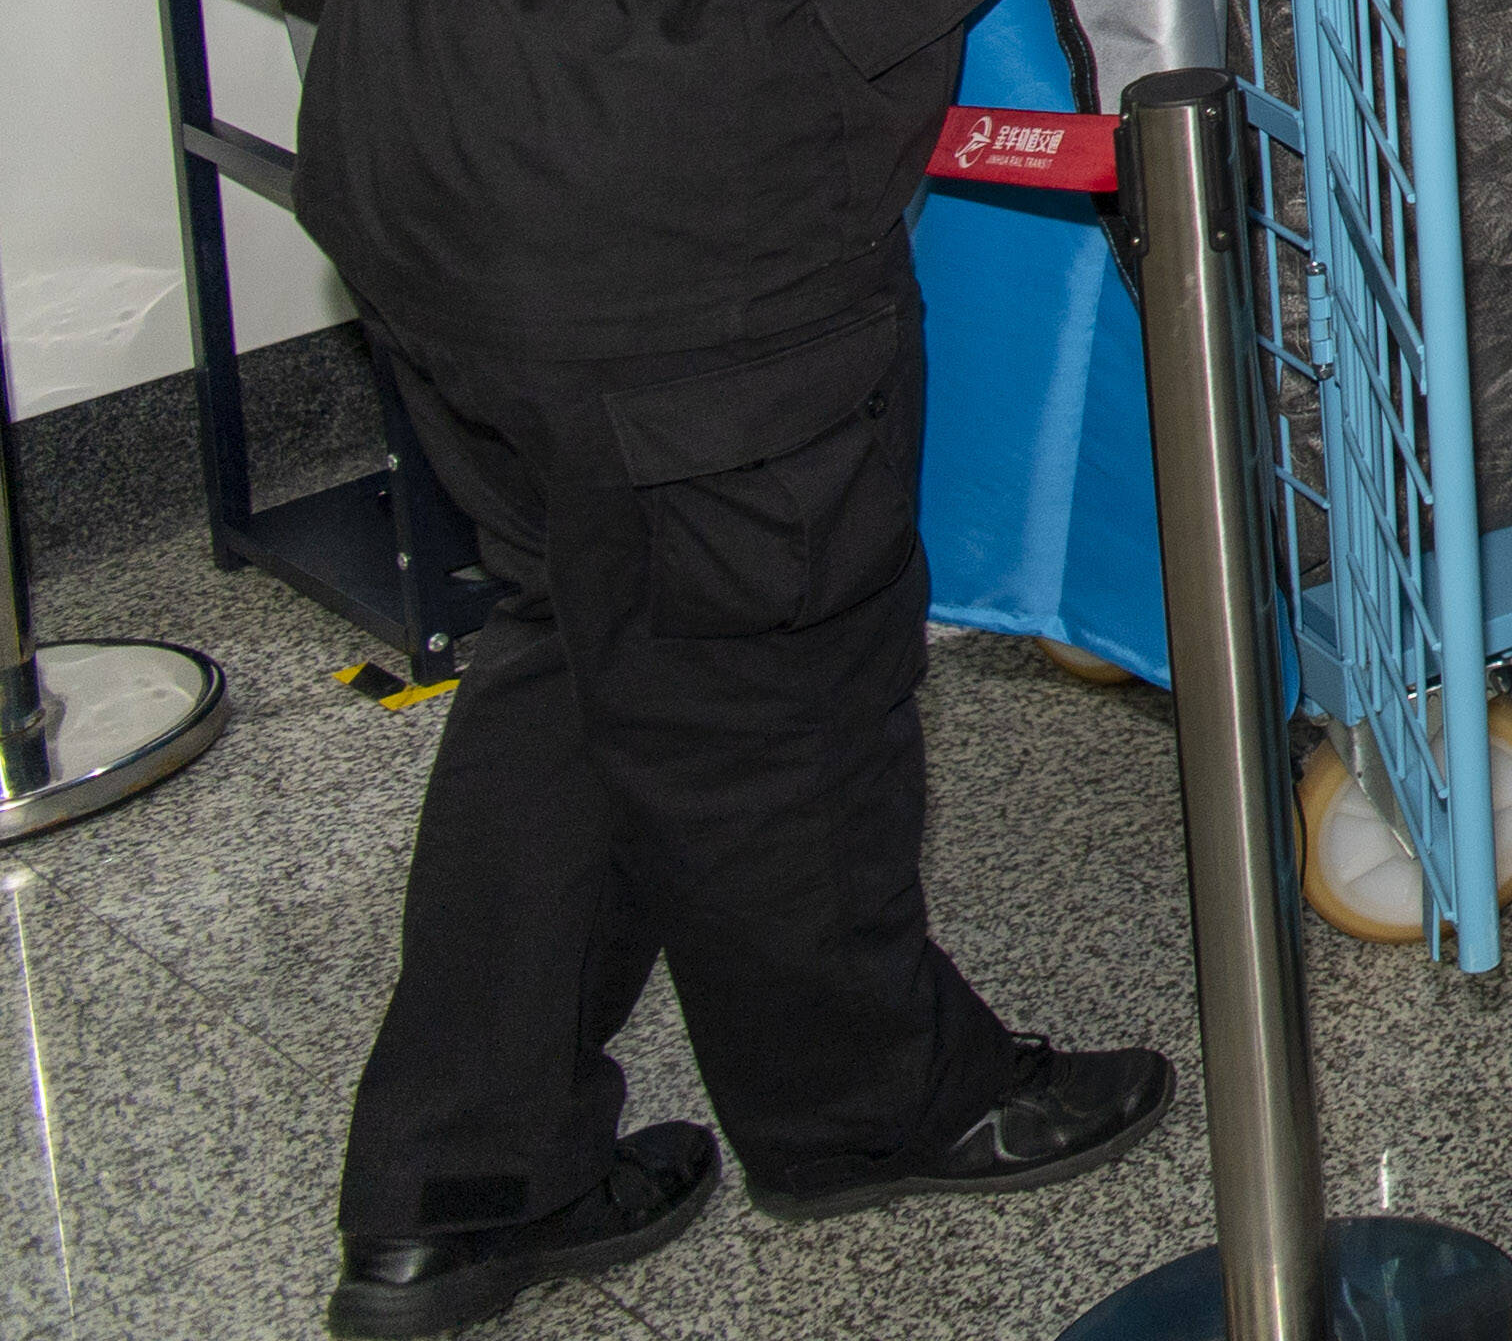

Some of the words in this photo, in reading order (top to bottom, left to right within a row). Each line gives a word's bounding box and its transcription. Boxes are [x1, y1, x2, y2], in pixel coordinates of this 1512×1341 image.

[993, 125, 1065, 154] 金华轨道交通
